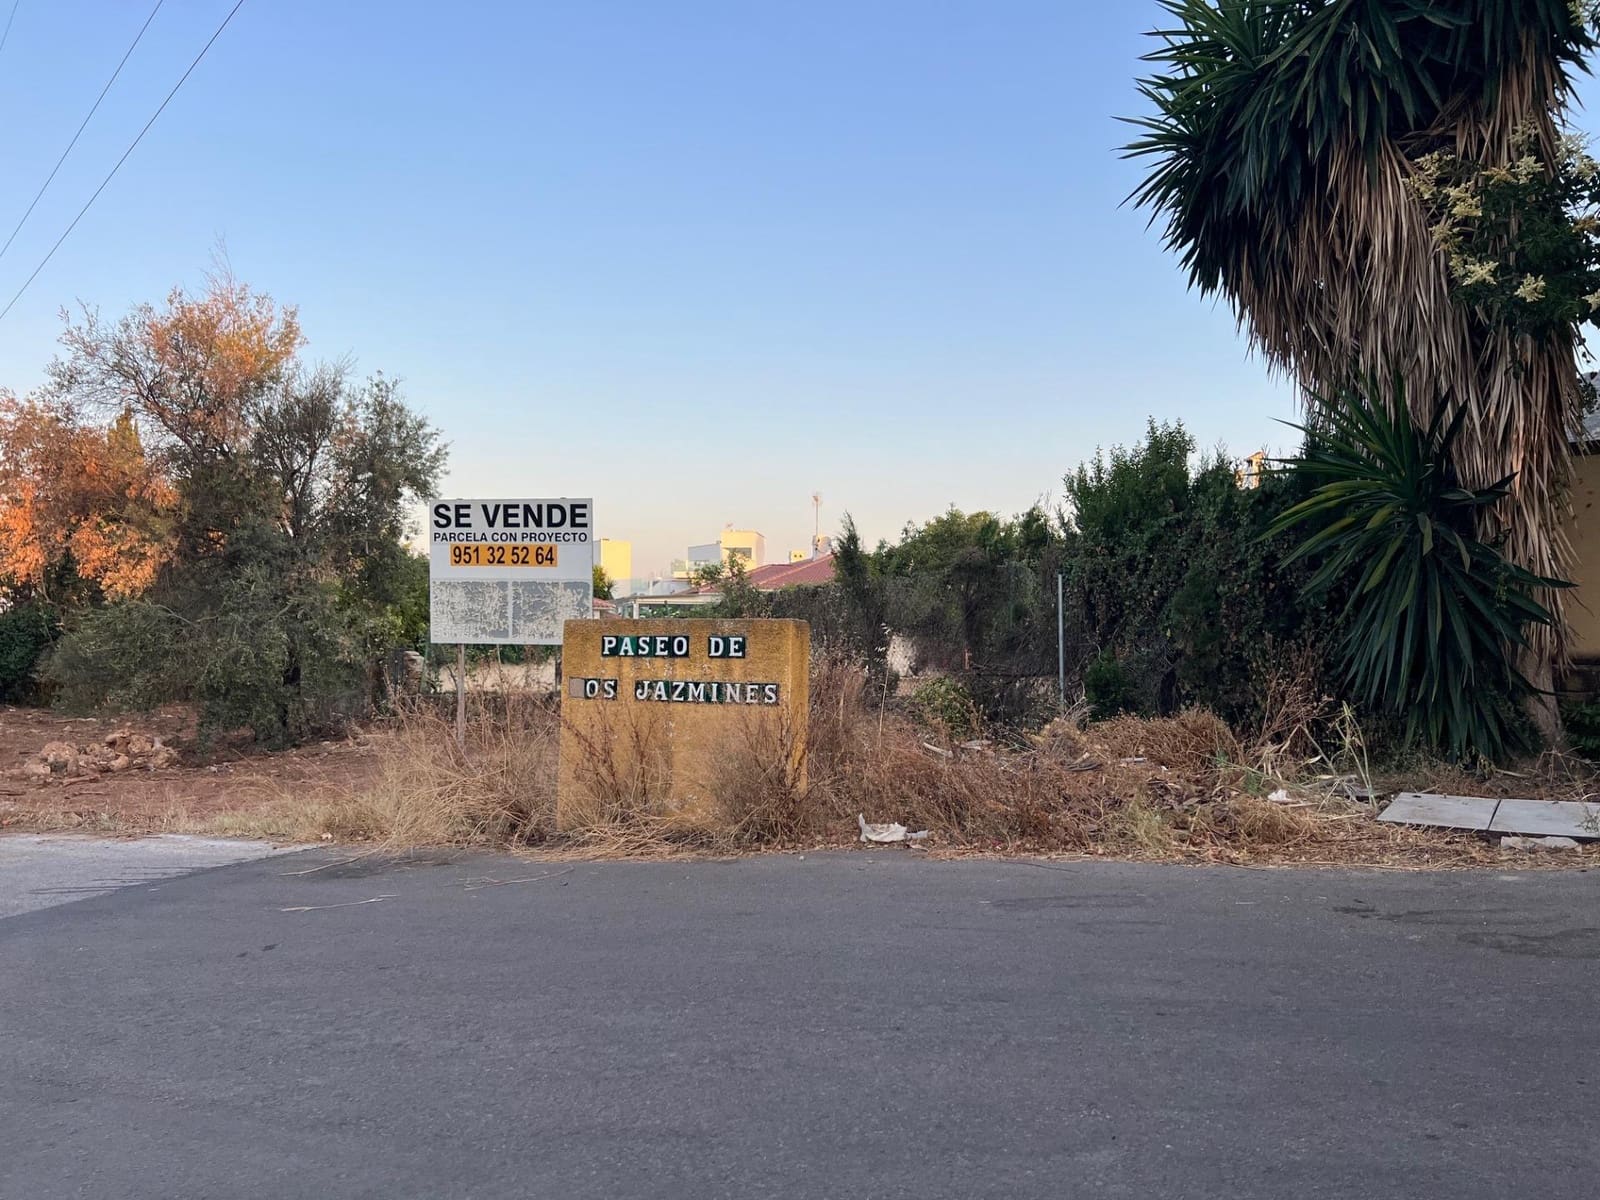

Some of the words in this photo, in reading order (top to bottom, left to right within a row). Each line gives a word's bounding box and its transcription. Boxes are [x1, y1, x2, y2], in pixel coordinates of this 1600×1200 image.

[433, 503, 472, 528] SE
[481, 503, 588, 528] VENDE
[433, 532, 488, 542] PARCELA
[491, 532, 517, 542] CON
[521, 532, 588, 542] PROYECTO
[453, 546, 480, 564] 951
[487, 546, 505, 564] 32
[511, 546, 530, 565] 52
[535, 546, 554, 565] 64
[602, 636, 688, 656] PASEO
[709, 637, 743, 657] DE
[635, 681, 777, 703] JAZMINES
